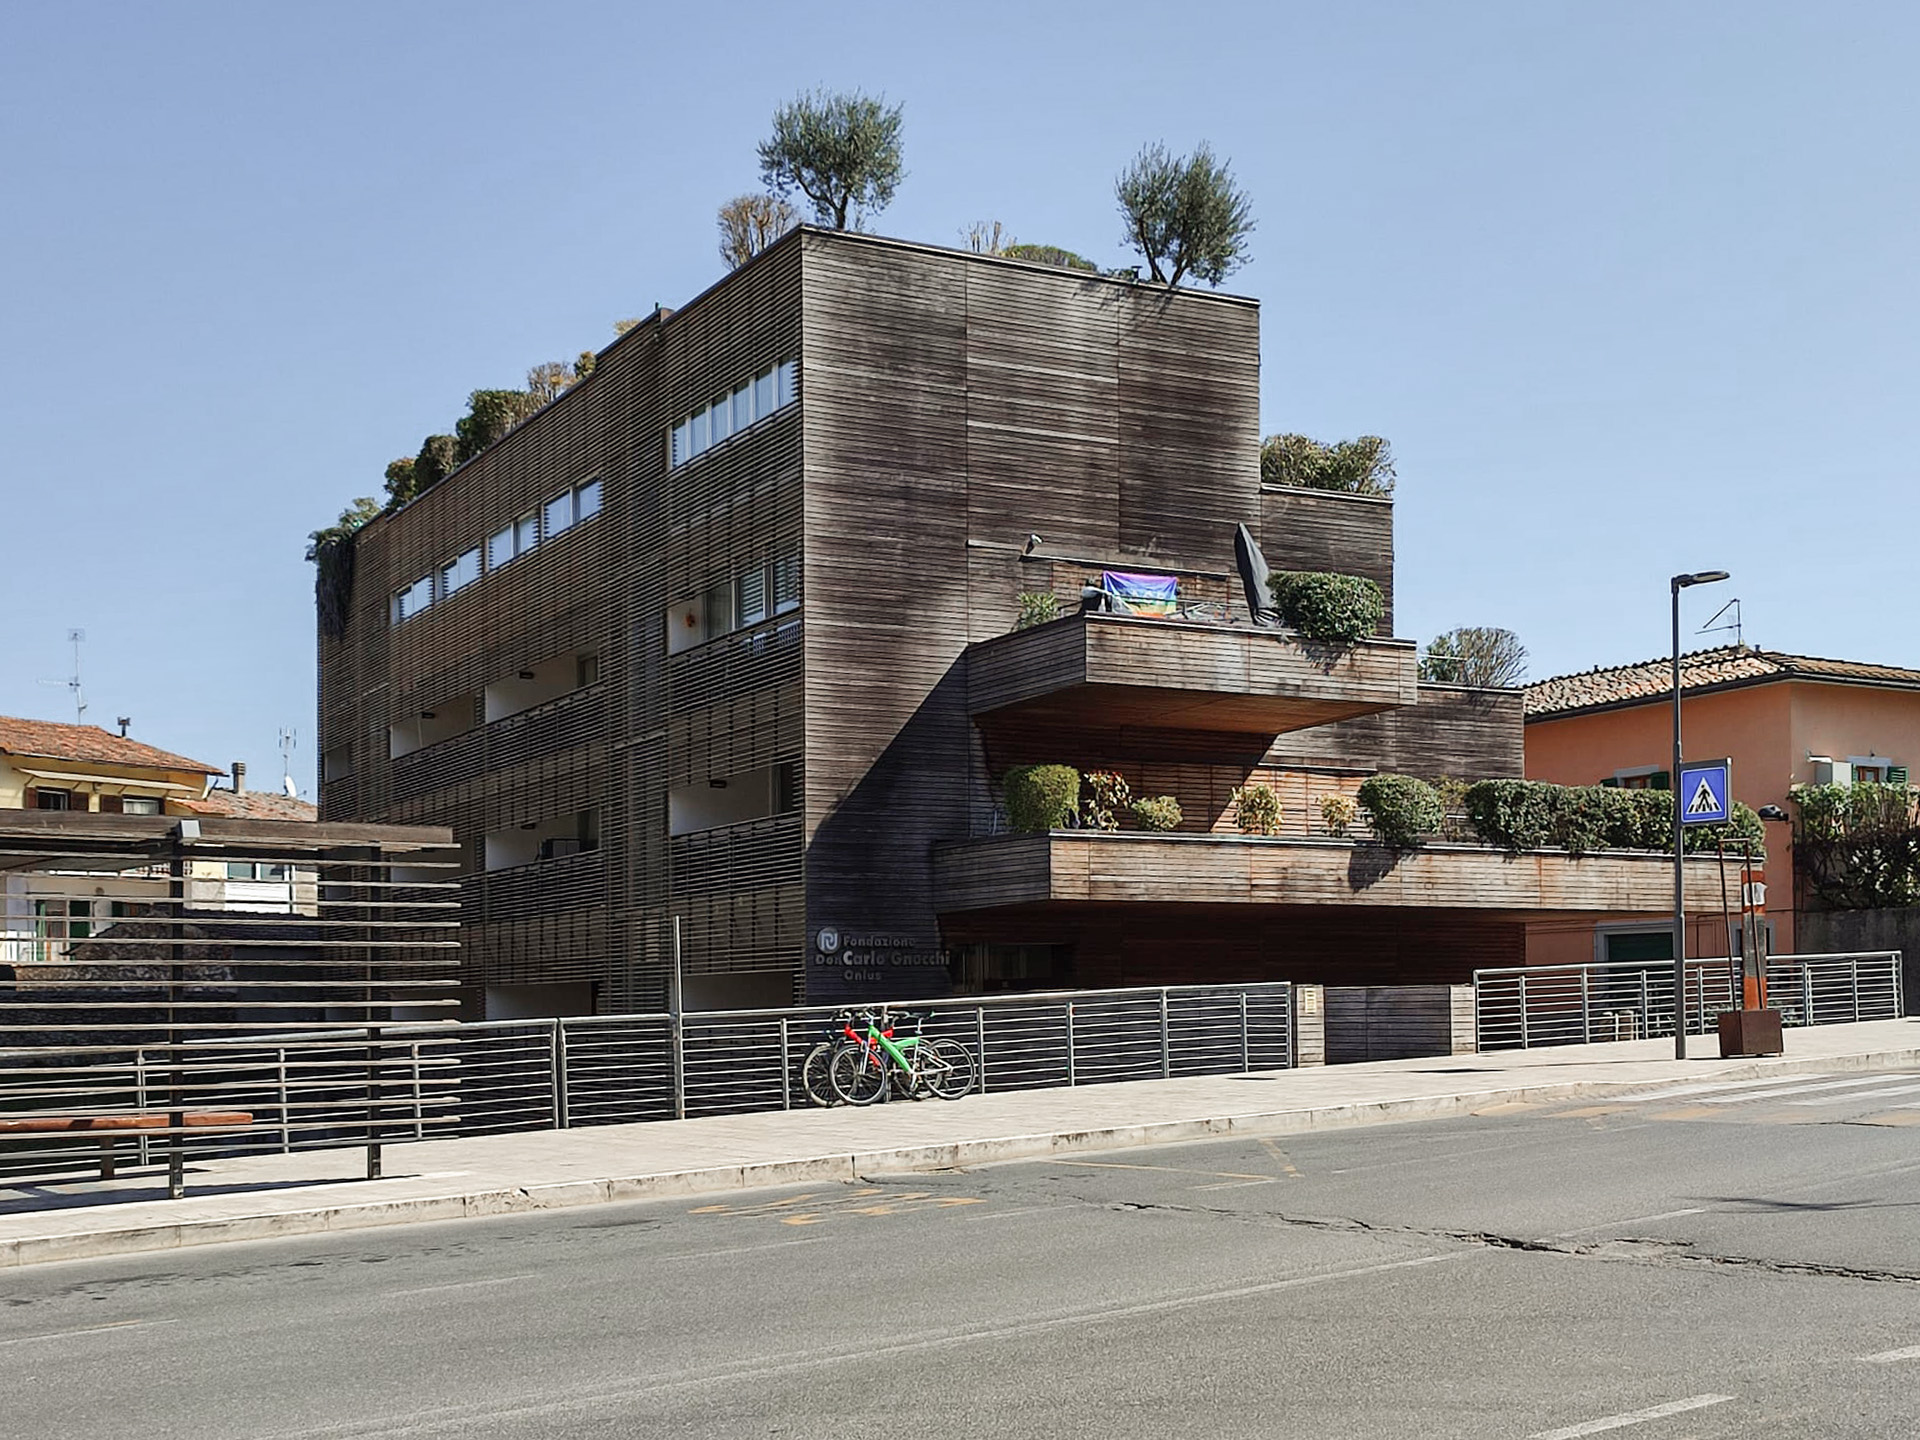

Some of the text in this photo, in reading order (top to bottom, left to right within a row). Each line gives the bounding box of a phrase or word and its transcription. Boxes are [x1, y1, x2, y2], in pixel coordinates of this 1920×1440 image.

[842, 934, 916, 947] Fondazione
[842, 950, 885, 966] Carlo
[843, 969, 882, 981] Onlus
